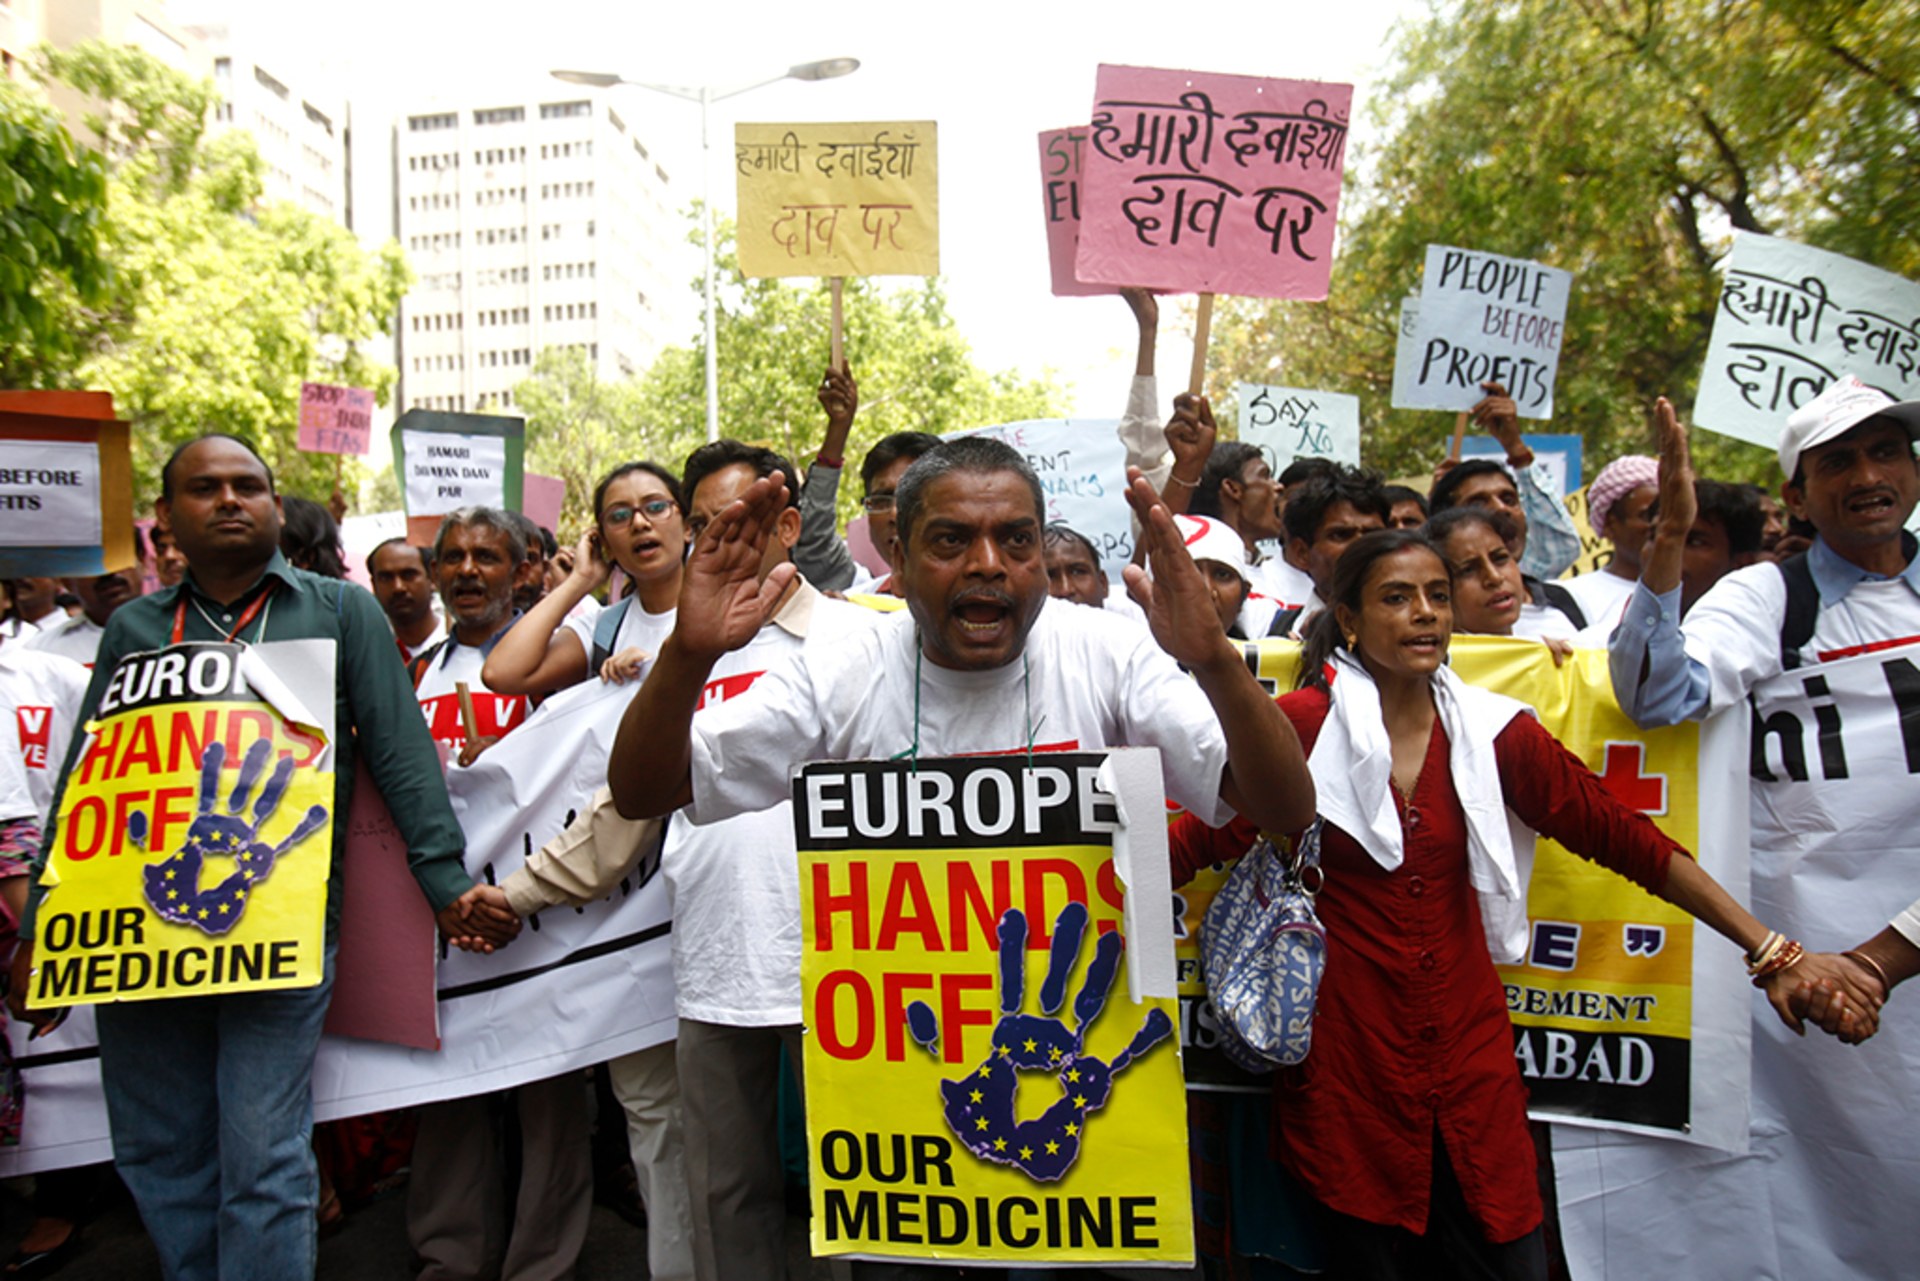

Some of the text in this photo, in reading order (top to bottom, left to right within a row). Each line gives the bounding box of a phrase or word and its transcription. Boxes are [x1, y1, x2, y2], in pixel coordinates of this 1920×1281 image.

[736, 131, 807, 177] हमारी
[1091, 91, 1224, 174] हमारी
[859, 204, 913, 250] पर
[1252, 186, 1328, 262] पर
[1438, 251, 1552, 309] PEOPLE
[1721, 268, 1841, 346] हमारी
[1482, 303, 1562, 350] BEFORE
[1418, 337, 1548, 408] PROFITS
[1249, 388, 1319, 429] SAY
[0, 468, 84, 487] BEFORE
[438, 485, 462, 498] PAR
[79, 709, 326, 786] HANDS
[64, 786, 195, 862] OFF
[805, 766, 1122, 840] EUROPE
[43, 906, 147, 953] OUR
[36, 939, 300, 1000] MEDICINE
[814, 969, 994, 1064] OFF
[819, 1129, 956, 1187] OUR
[825, 1189, 1160, 1249] MEDICINE
